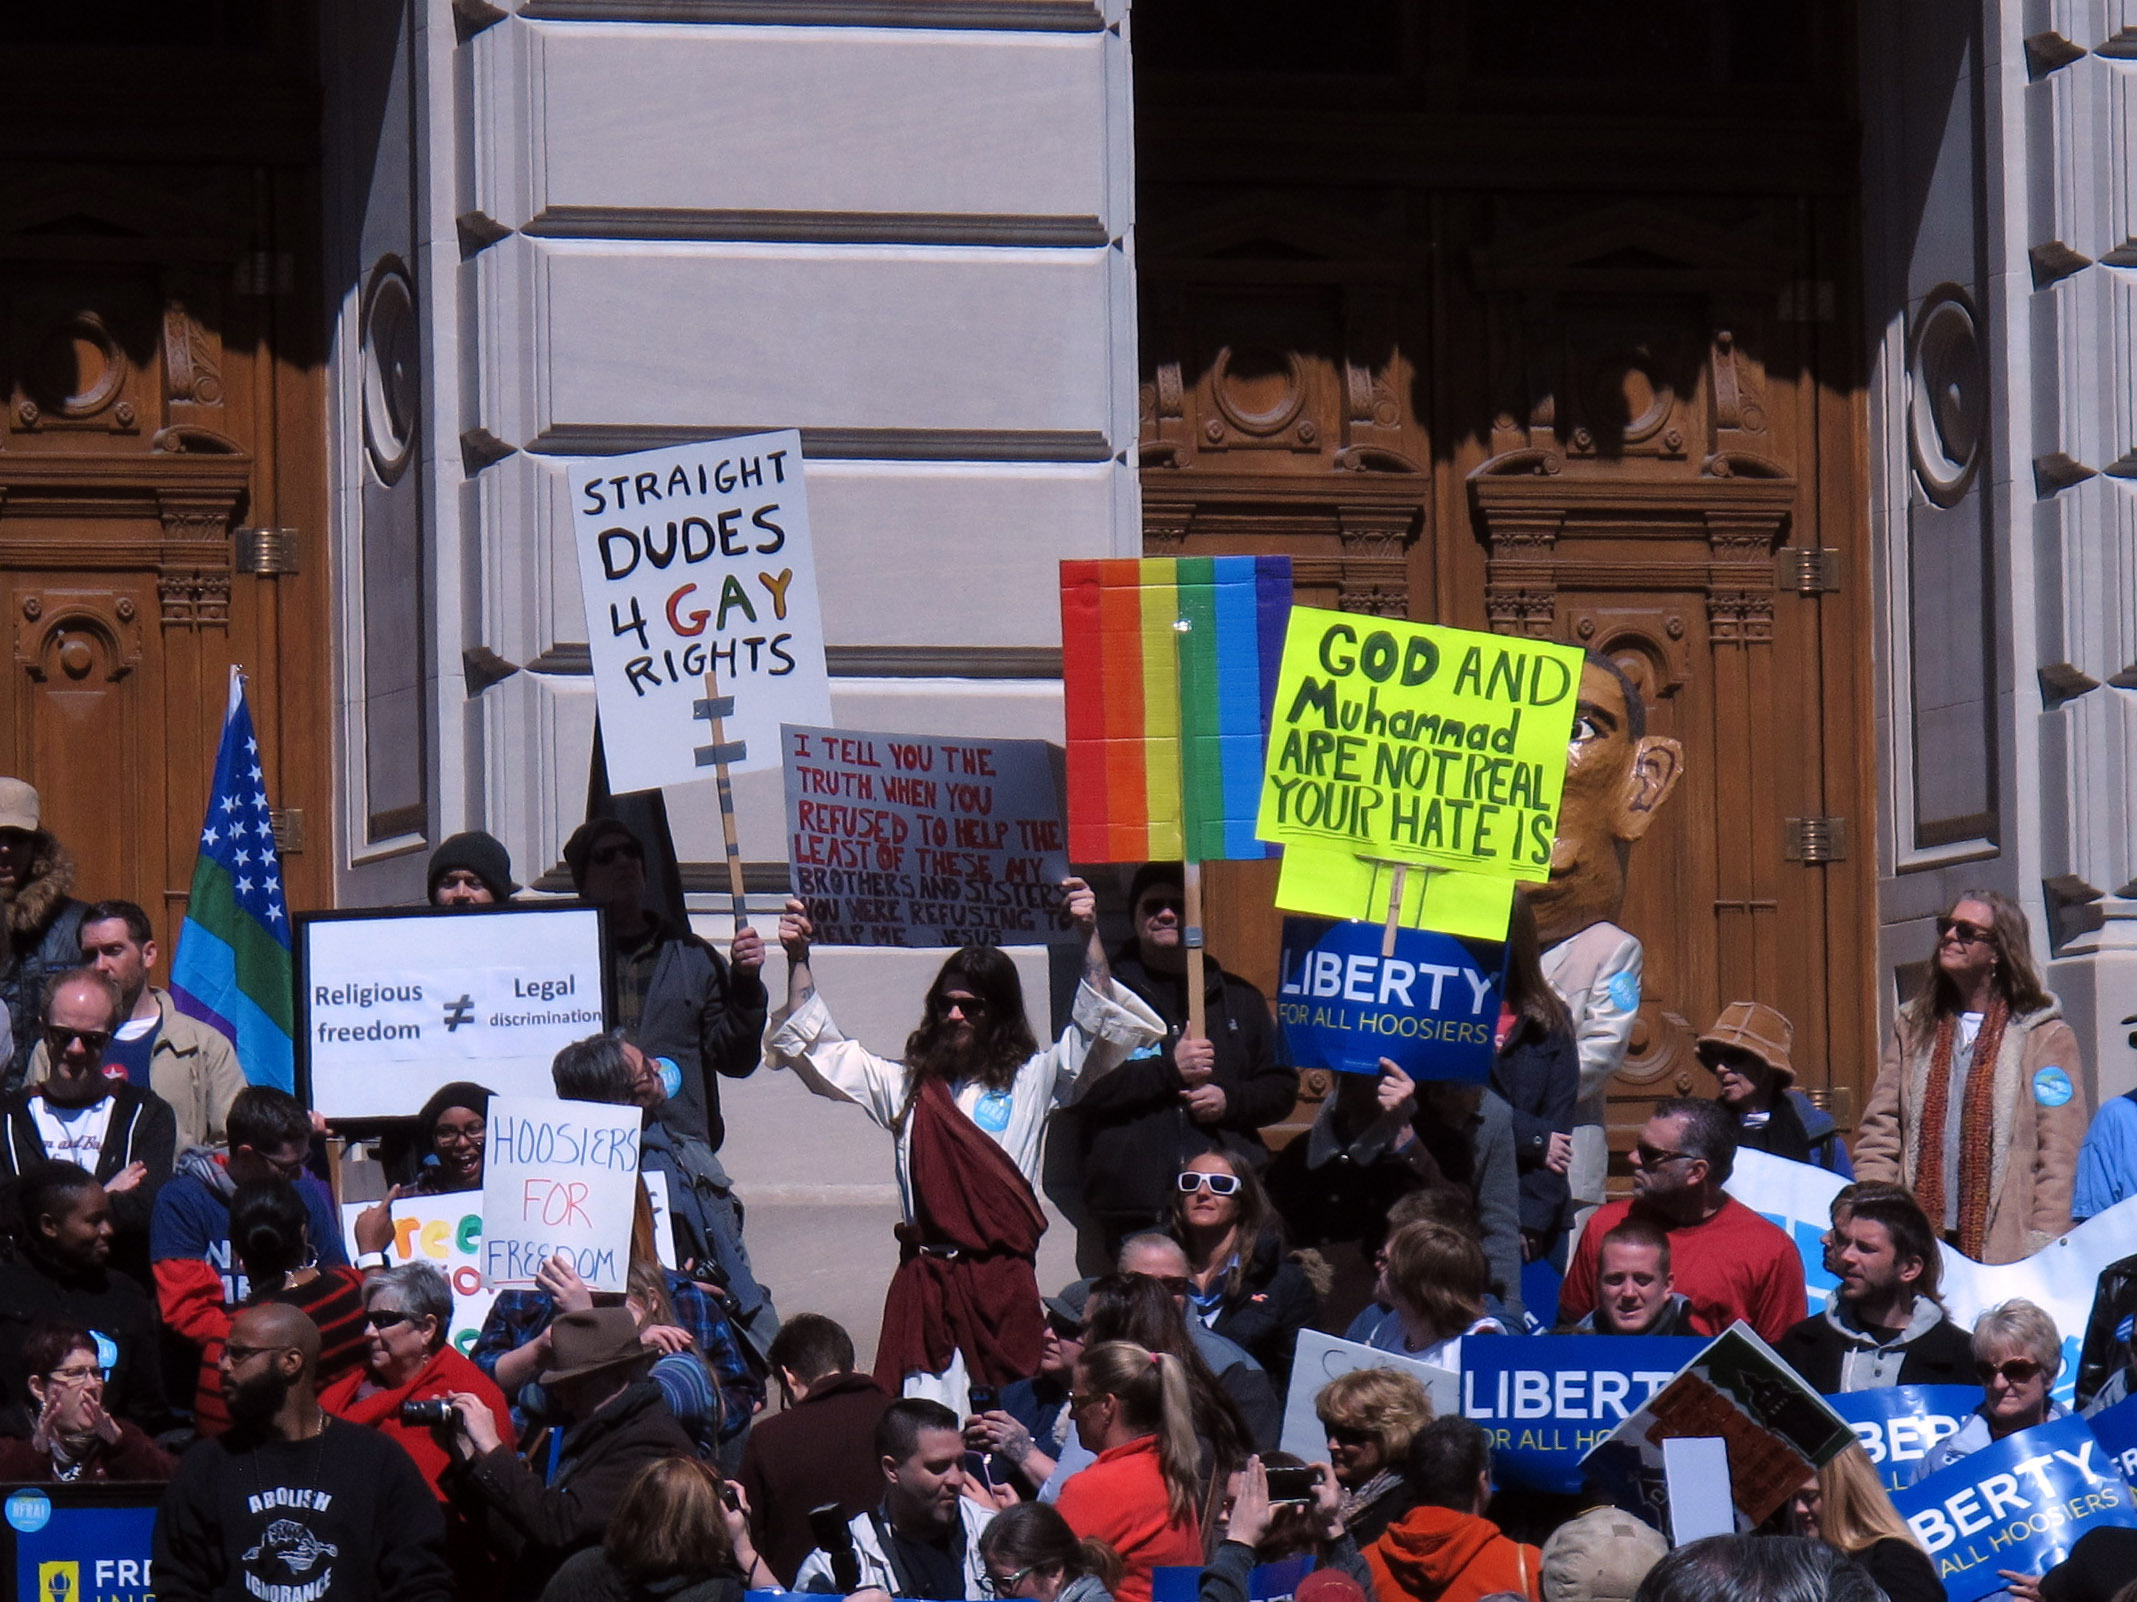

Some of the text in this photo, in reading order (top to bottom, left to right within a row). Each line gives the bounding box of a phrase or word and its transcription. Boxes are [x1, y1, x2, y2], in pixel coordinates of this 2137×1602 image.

[583, 450, 787, 515] STRAIGHT
[598, 504, 785, 580] DUDES
[610, 568, 792, 650] 4 GAY
[625, 633, 796, 696] RIGHTS
[1319, 624, 1571, 706] GOD AND
[1286, 675, 1521, 755] Muhammad
[794, 734, 996, 776] I TELL YOU THE
[1279, 728, 1550, 811] ARE NOT REAL
[881, 776, 936, 809] WHEN
[946, 782, 993, 816] YOU
[1270, 774, 1553, 866] YOUR HATE IS
[798, 800, 1063, 852] REFUSED TO HELP THE
[794, 834, 1044, 884] LEAST OF THESE MY
[797, 866, 915, 899] BROTHERS
[920, 876, 960, 901] AND
[802, 897, 839, 923] YOU
[845, 898, 903, 924] WERE
[910, 902, 1036, 932] REFUSING
[872, 926, 906, 946] ME
[941, 928, 1003, 947] JESUS
[315, 982, 423, 1008] Religious
[513, 974, 576, 1000] Legal
[1282, 949, 1502, 1015] LIBERTY
[317, 1019, 421, 1042] freedom
[489, 1009, 603, 1027] discrimination
[1279, 1003, 1489, 1045] FOR ALL HOOSIERS
[494, 1116, 638, 1172] HOOSIERS
[524, 1178, 592, 1228] FOR
[488, 1240, 616, 1282] FREEDOM
[1464, 1370, 1676, 1419] LIBERT
[1519, 1428, 1568, 1451] ALL
[248, 1487, 332, 1514] ABOLISH
[1907, 1440, 2099, 1556] BERTY
[1939, 1545, 1989, 1579] ALL
[1989, 1487, 2120, 1553] HOOSIERS
[245, 1566, 332, 1602] IGNORANCE
